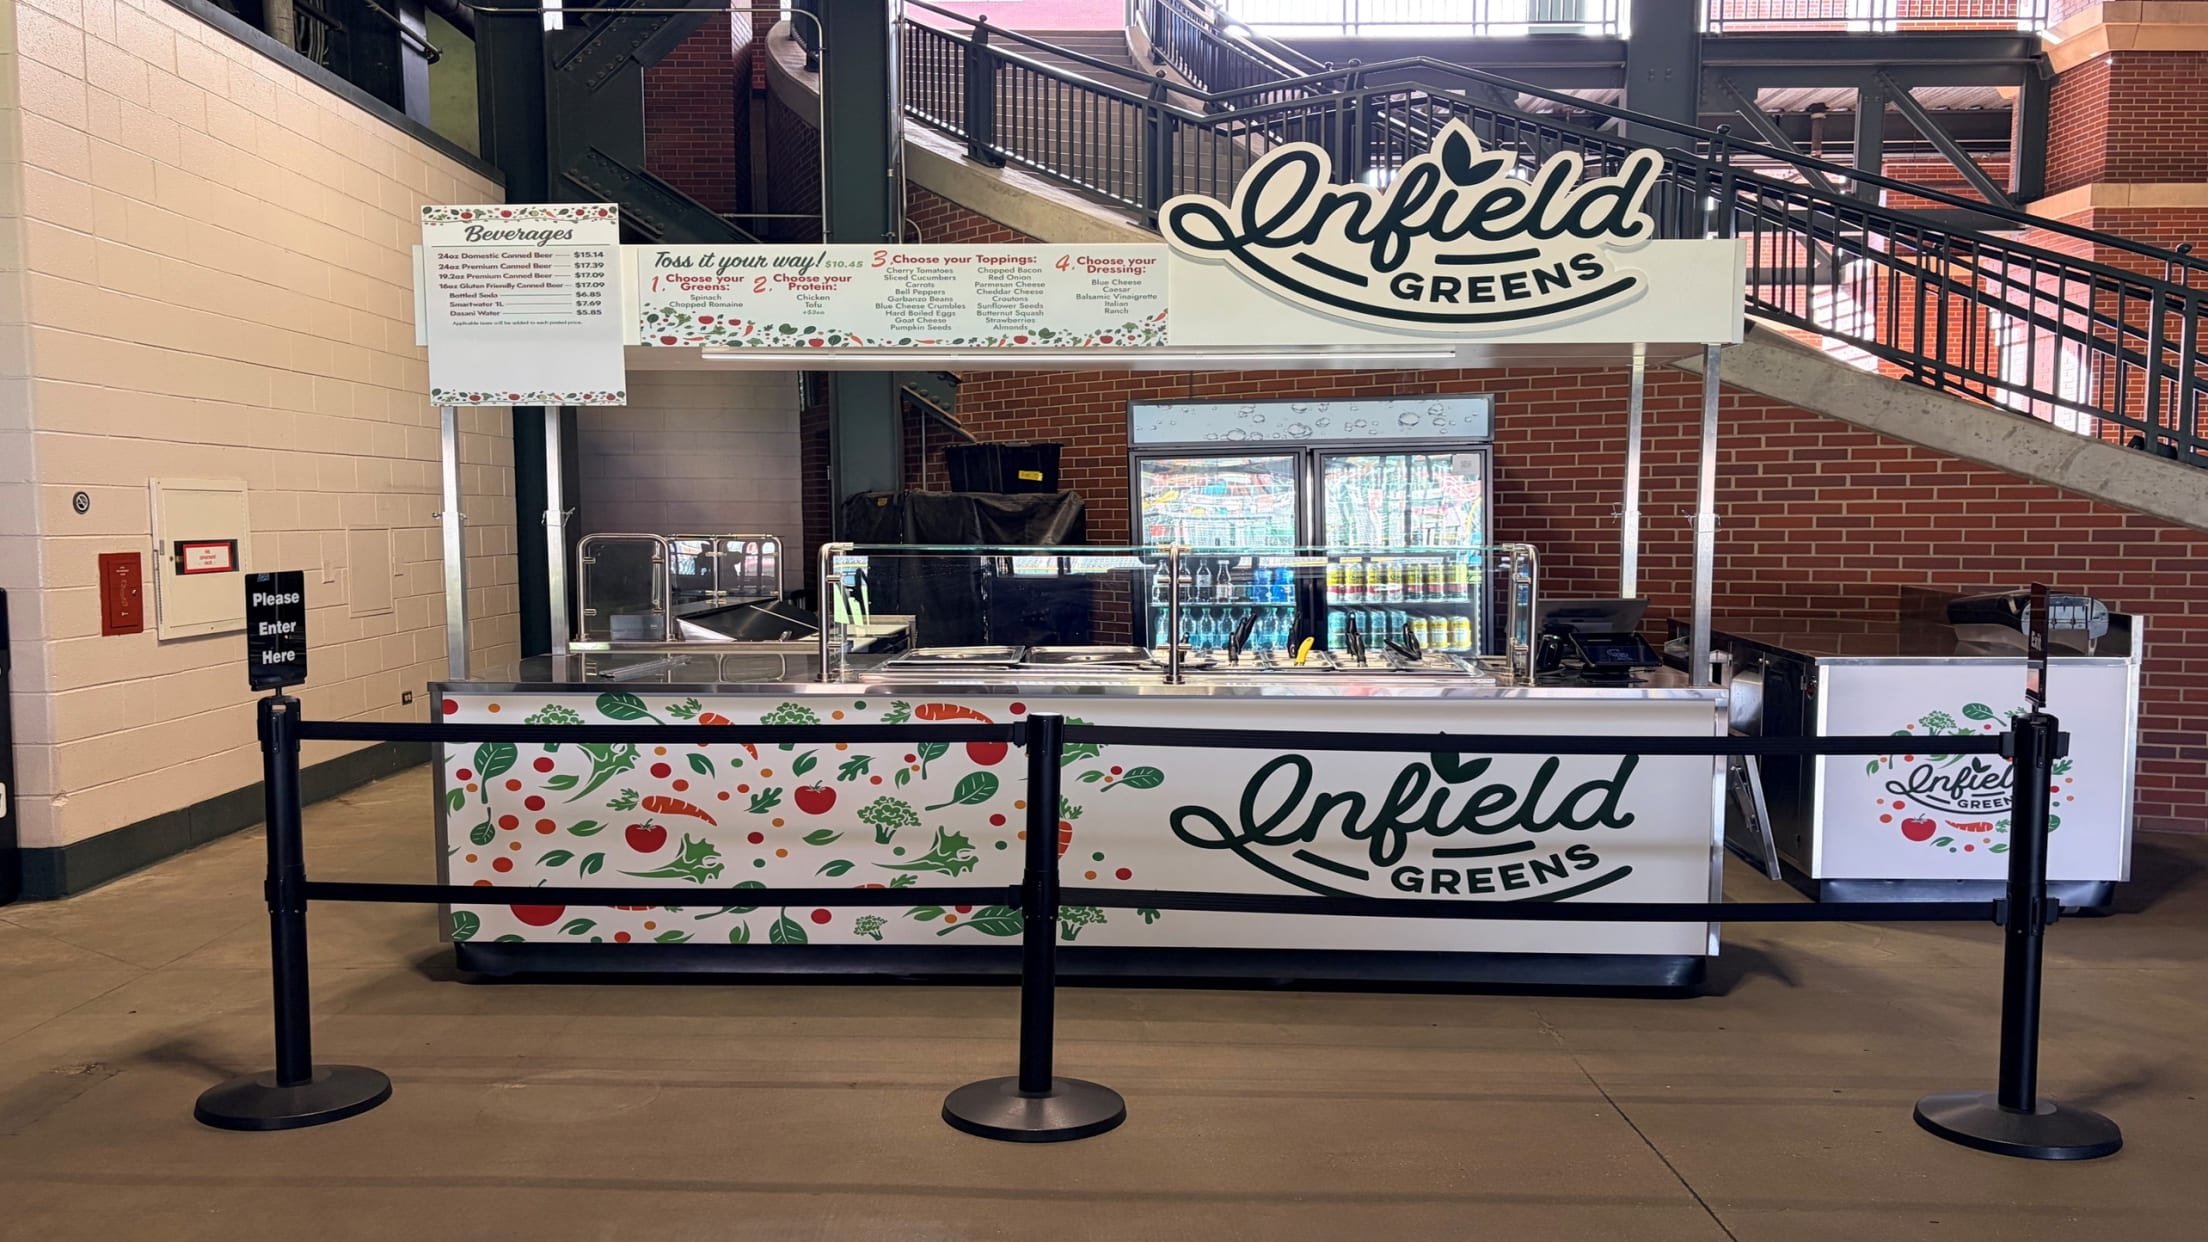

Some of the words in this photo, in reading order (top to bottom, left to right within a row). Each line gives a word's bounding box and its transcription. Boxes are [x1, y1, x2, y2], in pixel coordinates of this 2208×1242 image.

[1169, 149, 1651, 273] Infield
[465, 225, 573, 247] Beverages
[655, 251, 694, 268] Toss
[698, 252, 716, 268] it
[716, 255, 768, 276] your
[772, 250, 827, 276] way!
[825, 260, 864, 268] $10.45
[892, 254, 940, 264] Choose
[943, 256, 973, 266] your
[975, 254, 1037, 265] Toppings:
[1076, 256, 1124, 265] Choose
[1127, 258, 1157, 267] your
[1086, 264, 1146, 275] Dressing:
[666, 273, 712, 283] Choose
[716, 275, 744, 284] your
[773, 273, 820, 282] Choose
[823, 275, 852, 283] your
[1390, 251, 1604, 304] GREENS
[680, 282, 731, 291] Greens:
[788, 282, 838, 291] Protein:
[912, 288, 946, 296] Peppers
[690, 294, 722, 302] Spinach
[887, 295, 928, 303] Garbanzo
[1112, 293, 1158, 301] Vinaigrette
[669, 301, 707, 309] Chopped
[927, 302, 967, 310] Crumbles
[936, 310, 957, 318] Eggs
[1015, 309, 1044, 317] Squash
[890, 324, 925, 332] Pumpkin
[252, 592, 300, 607] Please
[258, 620, 297, 636] Enter
[262, 650, 296, 665] Here
[1885, 763, 2015, 800] Infiel
[1957, 795, 2013, 809] GREEN
[1170, 753, 1640, 866] Infield
[1390, 843, 1600, 895] GREENS
